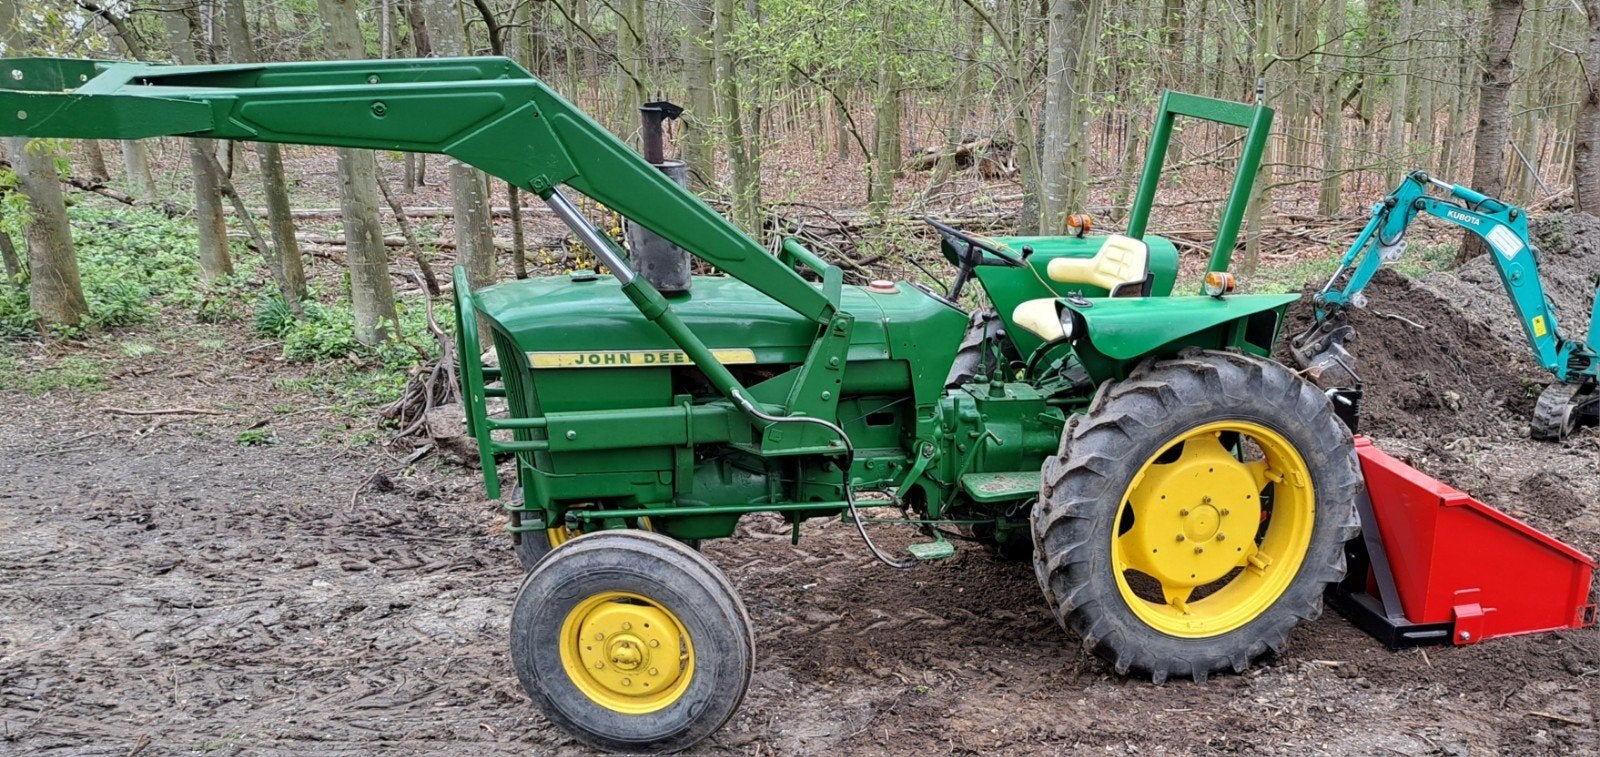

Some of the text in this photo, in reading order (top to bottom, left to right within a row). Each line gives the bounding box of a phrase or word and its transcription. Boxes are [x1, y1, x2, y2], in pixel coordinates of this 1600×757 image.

[1447, 210, 1480, 226] KUBOTA
[574, 352, 693, 365] JOHN DEE
